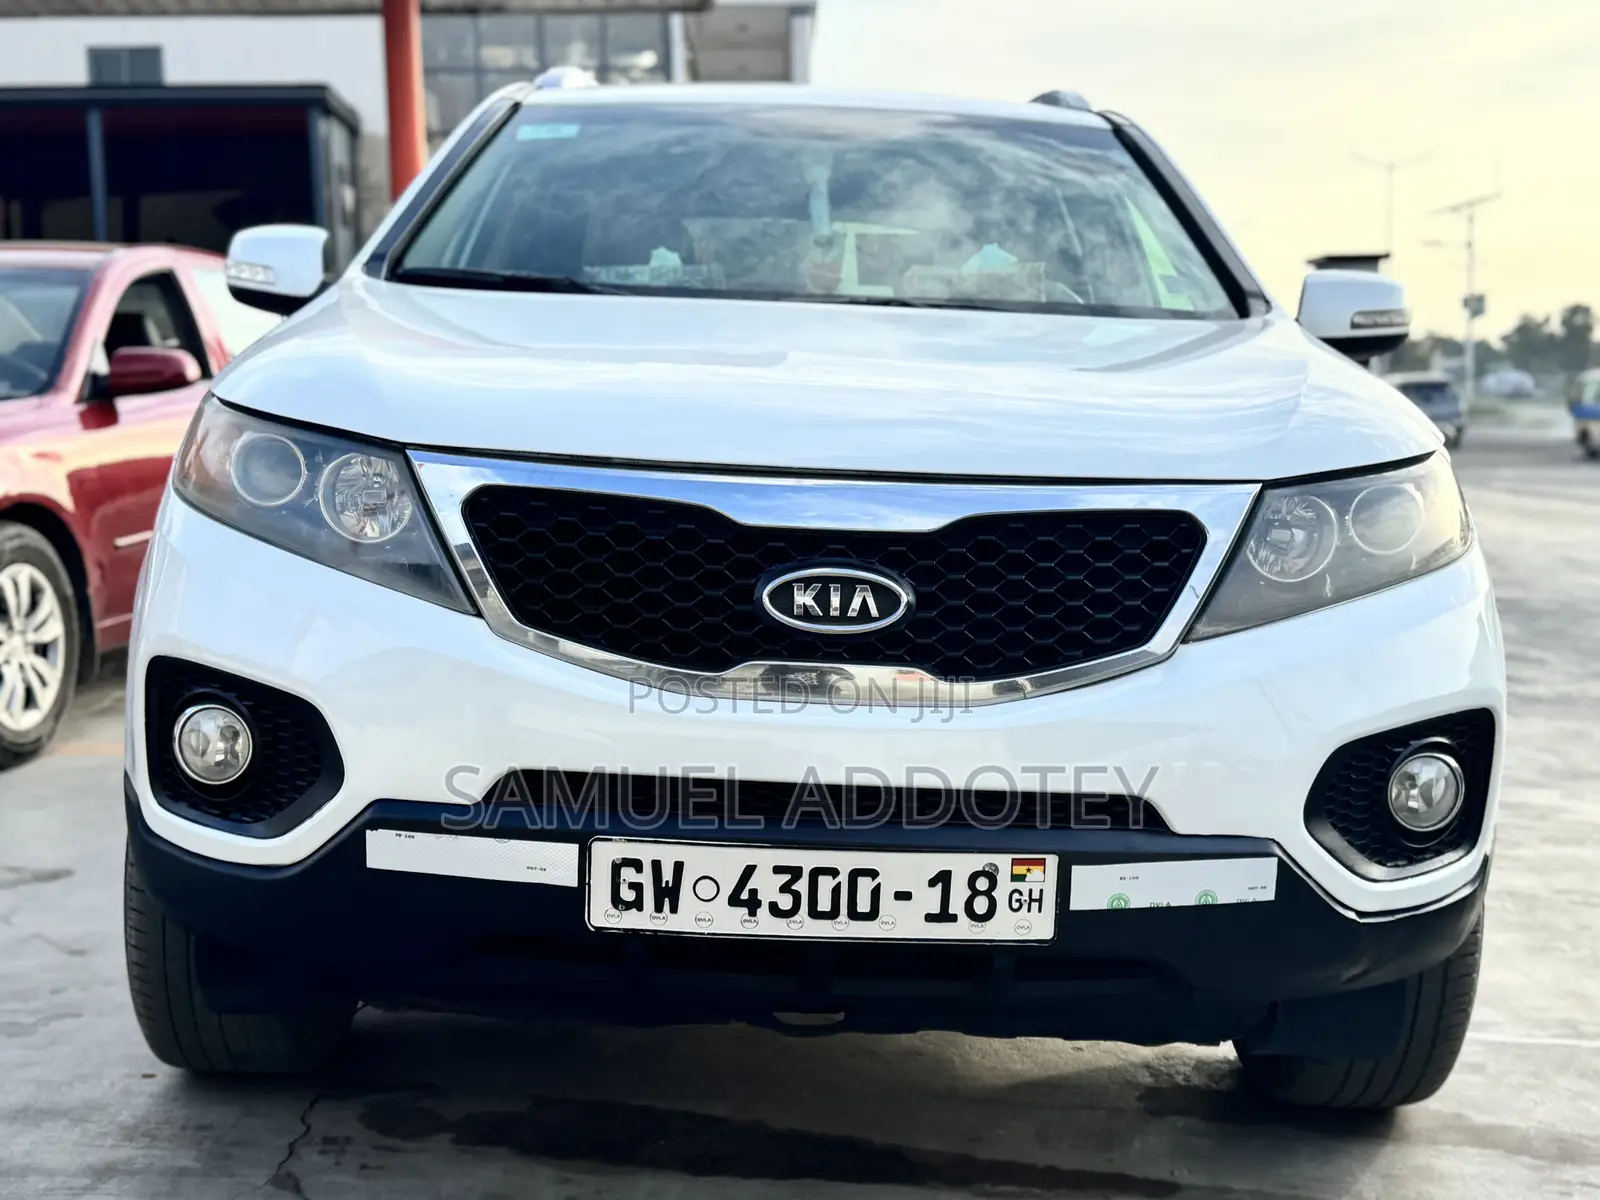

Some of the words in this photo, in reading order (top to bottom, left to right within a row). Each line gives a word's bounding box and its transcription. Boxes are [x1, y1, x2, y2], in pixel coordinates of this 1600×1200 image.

[792, 583, 880, 618] KIA
[611, 857, 685, 914] GW
[727, 864, 998, 923] 4300-18
[1007, 888, 1044, 914] GH
